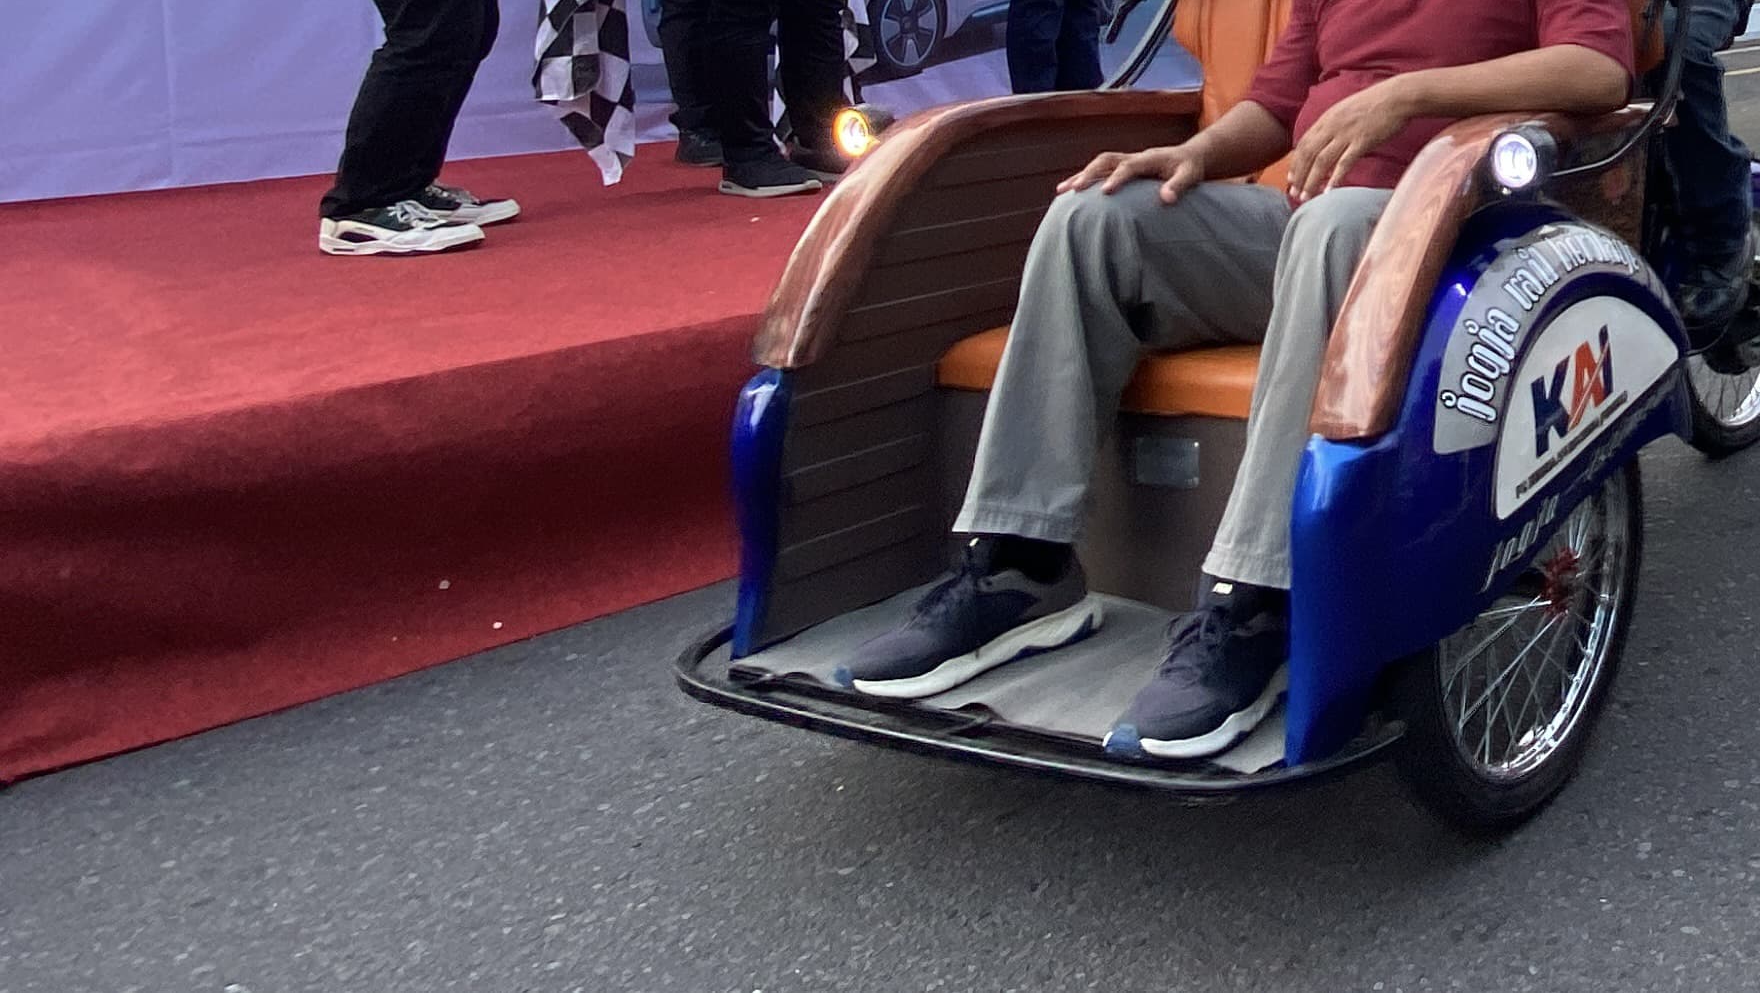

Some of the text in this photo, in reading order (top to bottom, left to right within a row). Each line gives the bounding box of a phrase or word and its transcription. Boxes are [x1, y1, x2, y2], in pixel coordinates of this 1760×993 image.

[1440, 307, 1520, 422] jogja
[1503, 245, 1560, 311] rail
[1530, 324, 1614, 458] KAI
